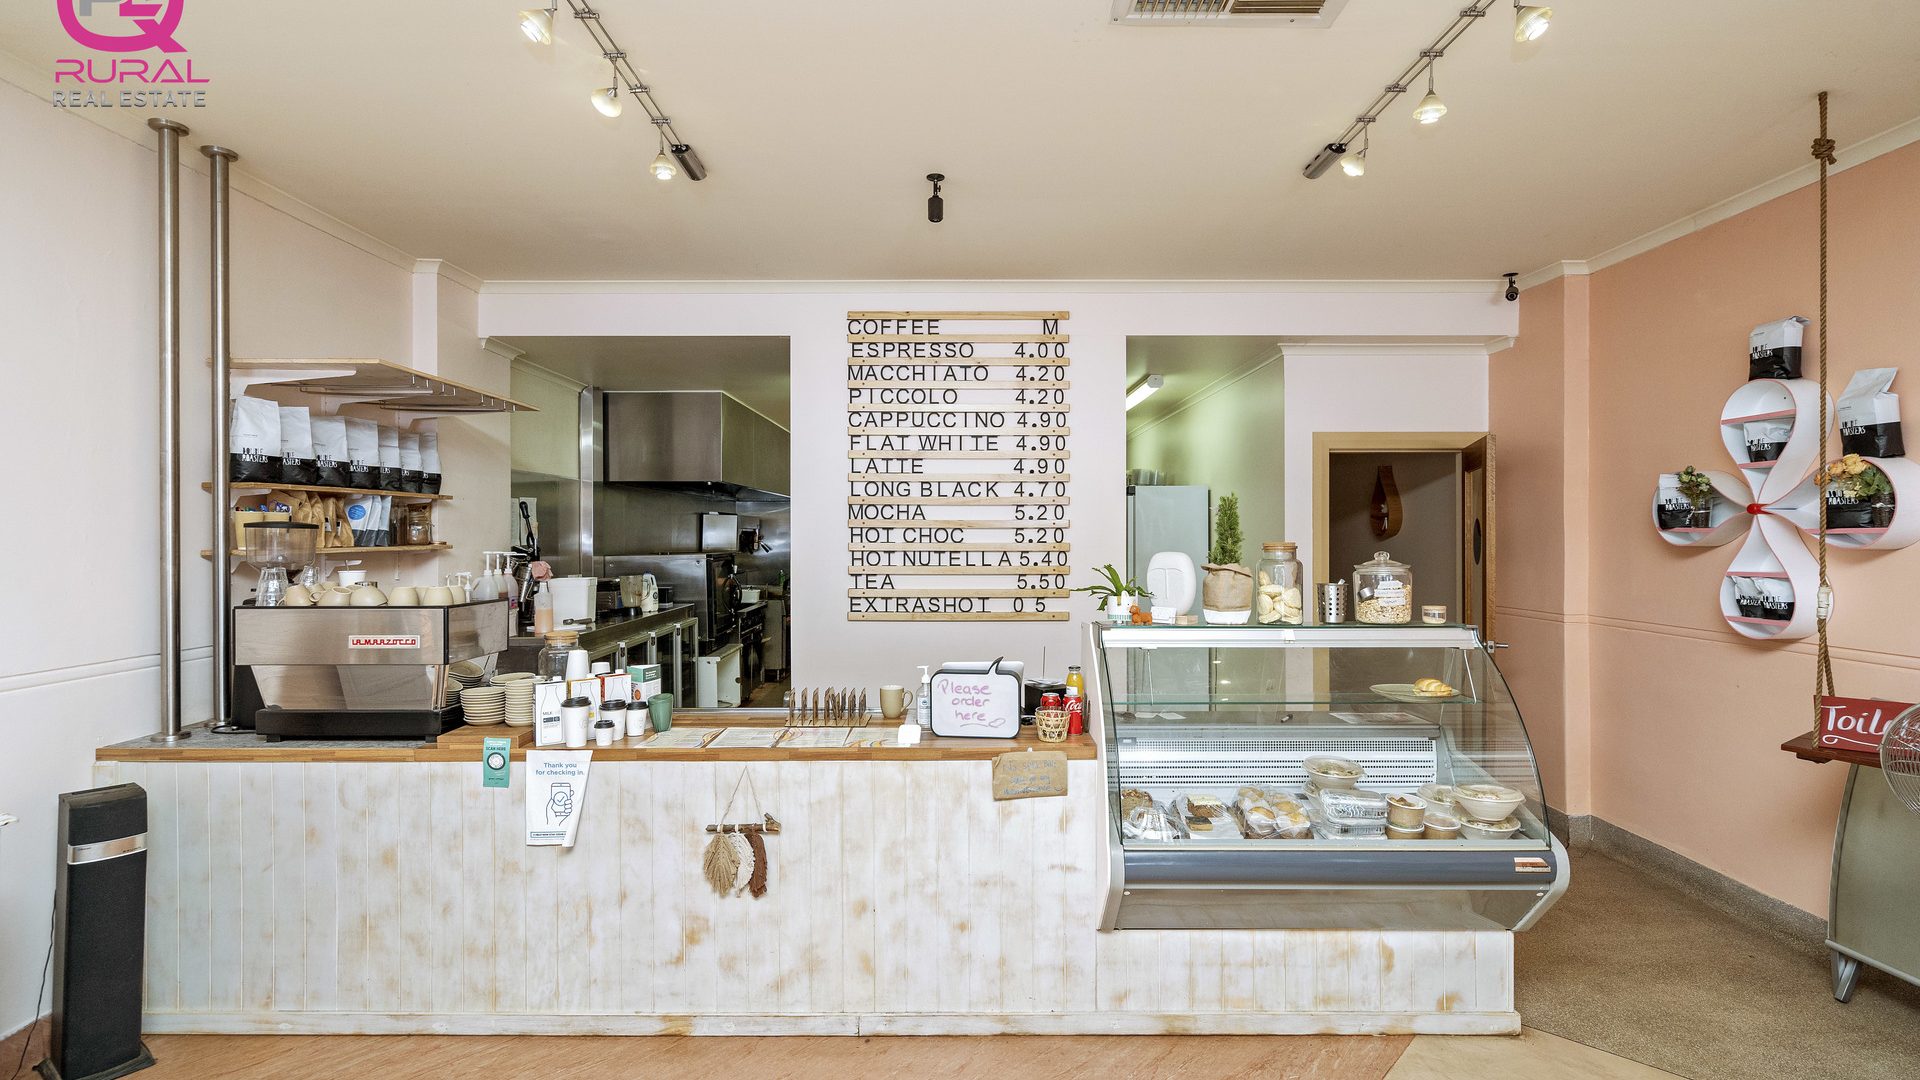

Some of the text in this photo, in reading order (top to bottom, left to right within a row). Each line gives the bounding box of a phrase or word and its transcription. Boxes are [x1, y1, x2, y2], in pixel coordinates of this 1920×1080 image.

[847, 320, 1058, 335] COFFEE M
[851, 343, 1065, 358] ESPRESSO 4.00
[847, 366, 1065, 381] MACCHIATO 4.20
[849, 389, 1064, 404] PICCOLO 4.20
[848, 412, 1066, 428] CAPPUCCINO 4.90
[850, 436, 1065, 451] FLAT WHITE 4.90
[851, 458, 1065, 474] LATTE 4.90
[850, 482, 1066, 498] LONG BLACK 4.70
[848, 505, 1065, 520] MOCHA 5.20
[850, 528, 1064, 544] HOT CHOC 5.20
[851, 552, 1068, 567] HOT NUTELLA 5.40
[853, 574, 1065, 590] TEA 5.50
[937, 679, 992, 695] Please
[951, 696, 990, 707] order
[954, 709, 987, 721] here
